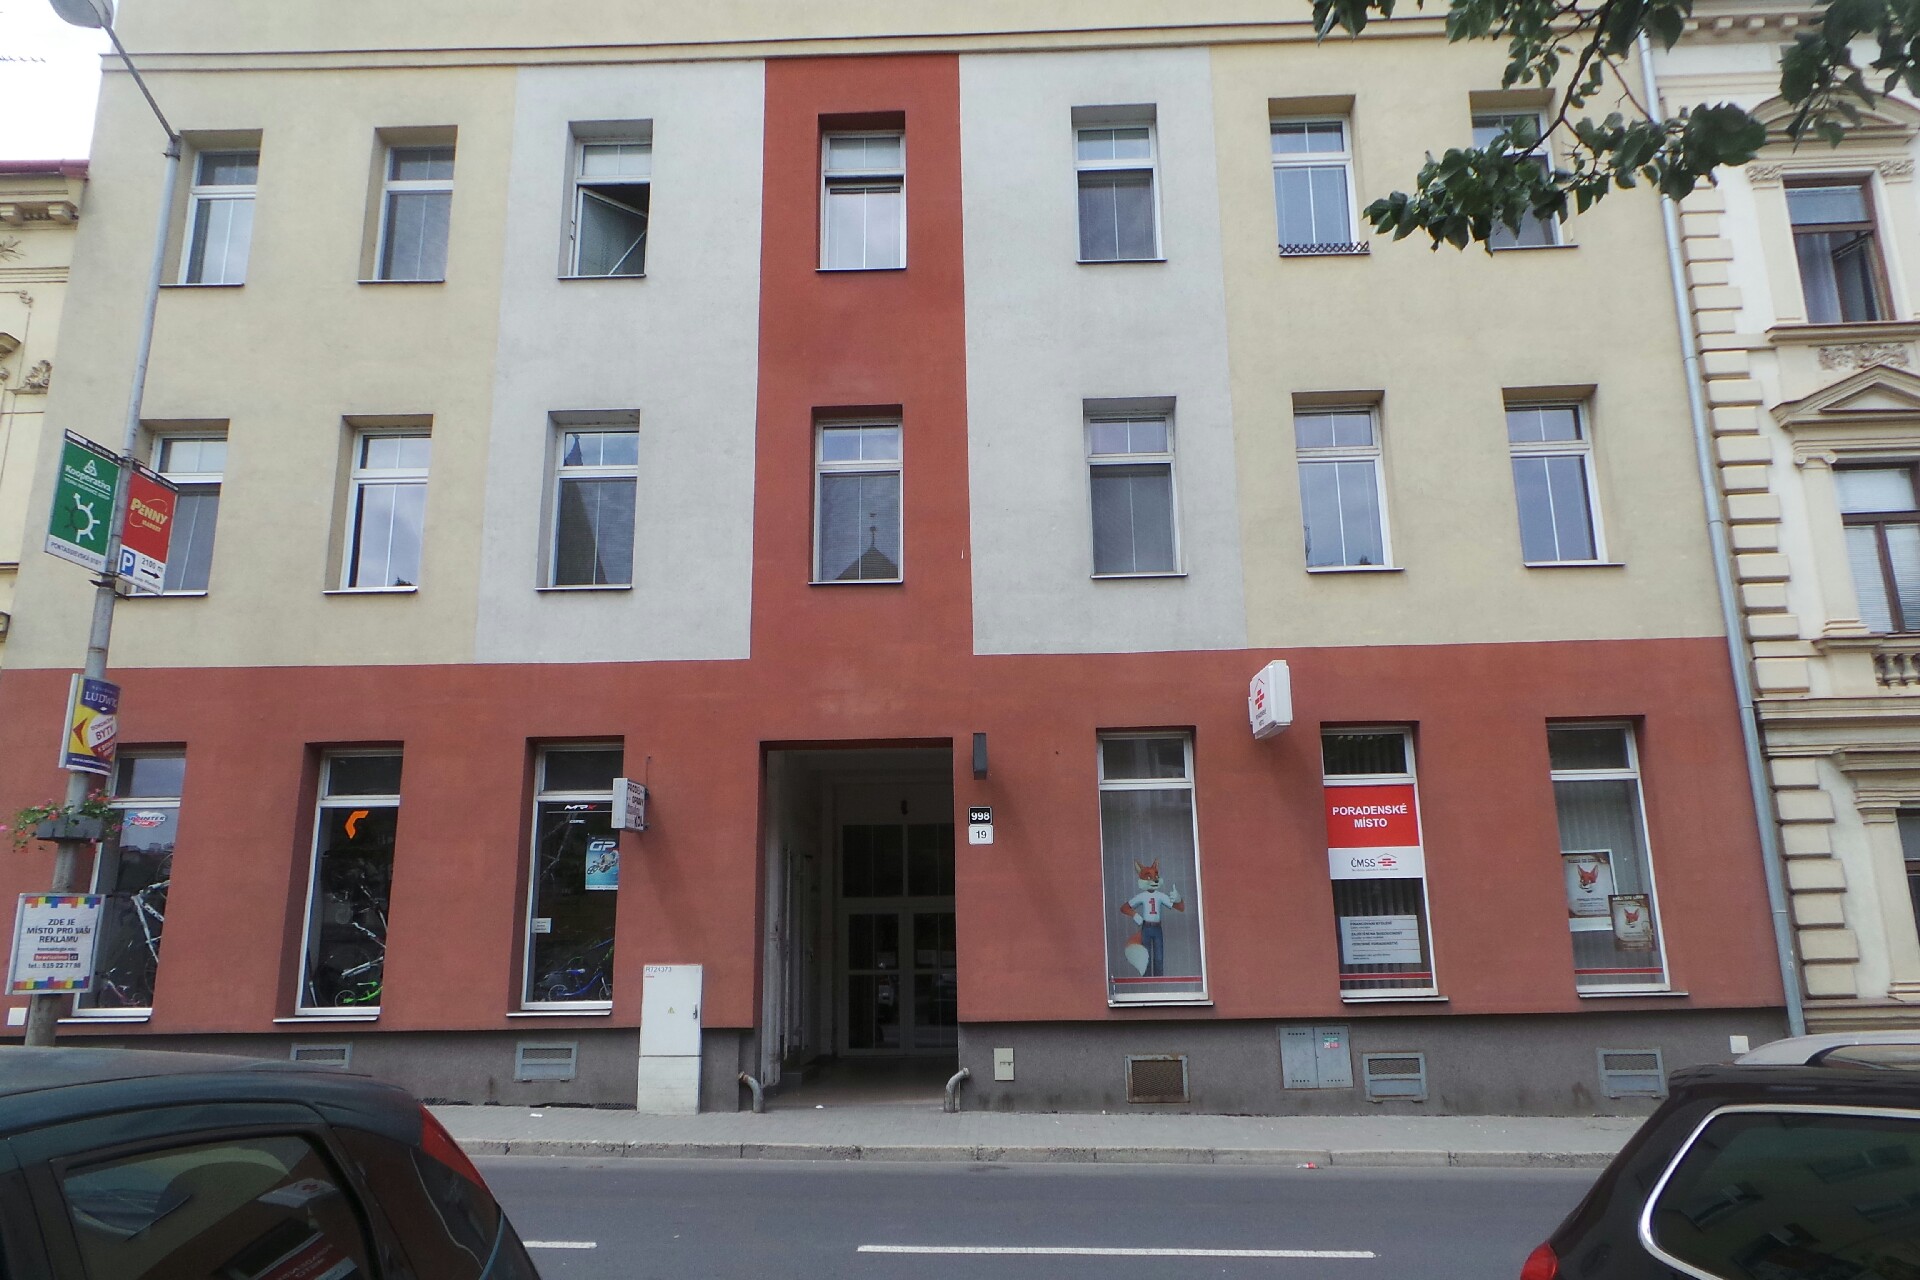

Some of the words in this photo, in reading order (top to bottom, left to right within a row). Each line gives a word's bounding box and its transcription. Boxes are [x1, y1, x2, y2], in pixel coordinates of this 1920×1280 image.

[65, 465, 111, 491] Kooperativa
[130, 497, 168, 524] PENNY
[1332, 803, 1408, 816] PORADENSKÉ
[971, 811, 990, 821] 998
[1354, 816, 1388, 828] MÍSTO
[976, 830, 987, 839] 19
[589, 841, 617, 852] GP
[1350, 857, 1376, 868] ČMSS
[48, 918, 65, 926] ZDE
[66, 918, 76, 926] JE
[26, 926, 54, 934] MÍSTO
[56, 927, 74, 935] PRO
[75, 926, 91, 935] VAŠI
[38, 935, 79, 943] REKLAMU
